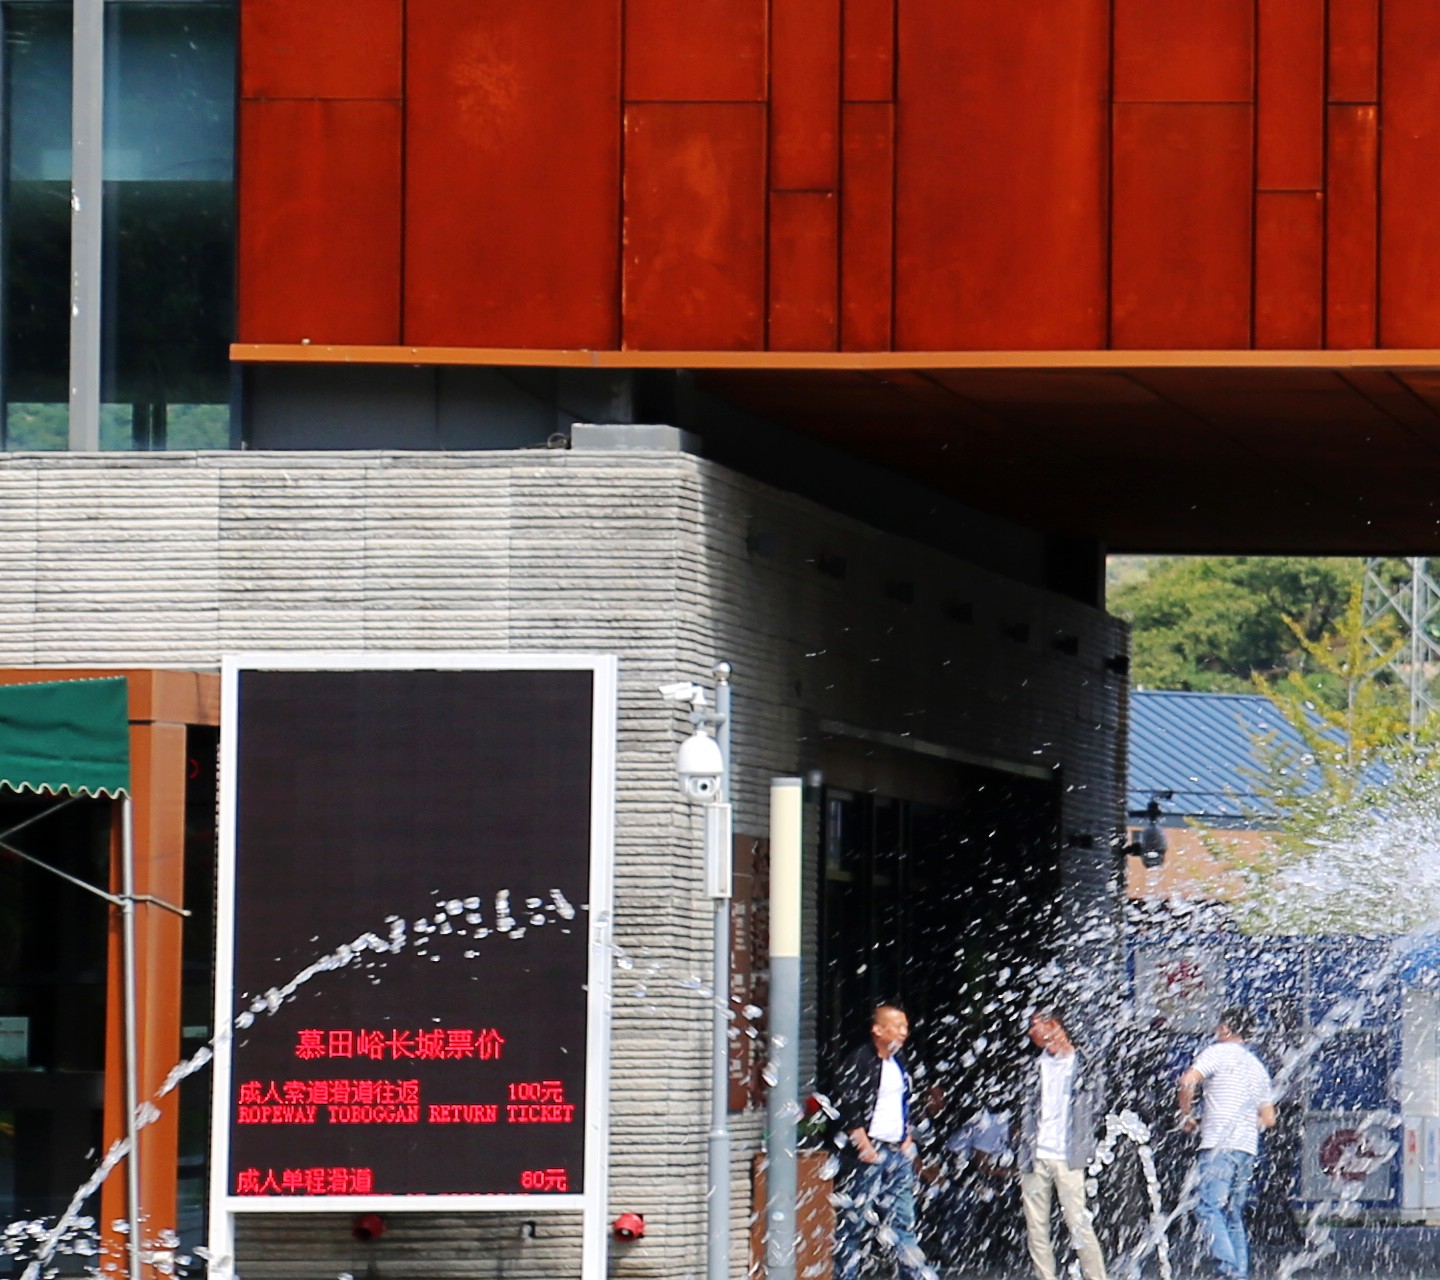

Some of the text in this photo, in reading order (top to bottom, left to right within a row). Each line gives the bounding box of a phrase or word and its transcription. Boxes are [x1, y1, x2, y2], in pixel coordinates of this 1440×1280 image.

[294, 1028, 505, 1061] 慕田峪长城票价
[238, 1078, 565, 1105] 成人索道滑道往返 100元
[237, 1105, 575, 1123] ROPEWAY TOBOGGAN RETURN TICKET
[236, 1167, 569, 1194] 成人单程滑道 80元
